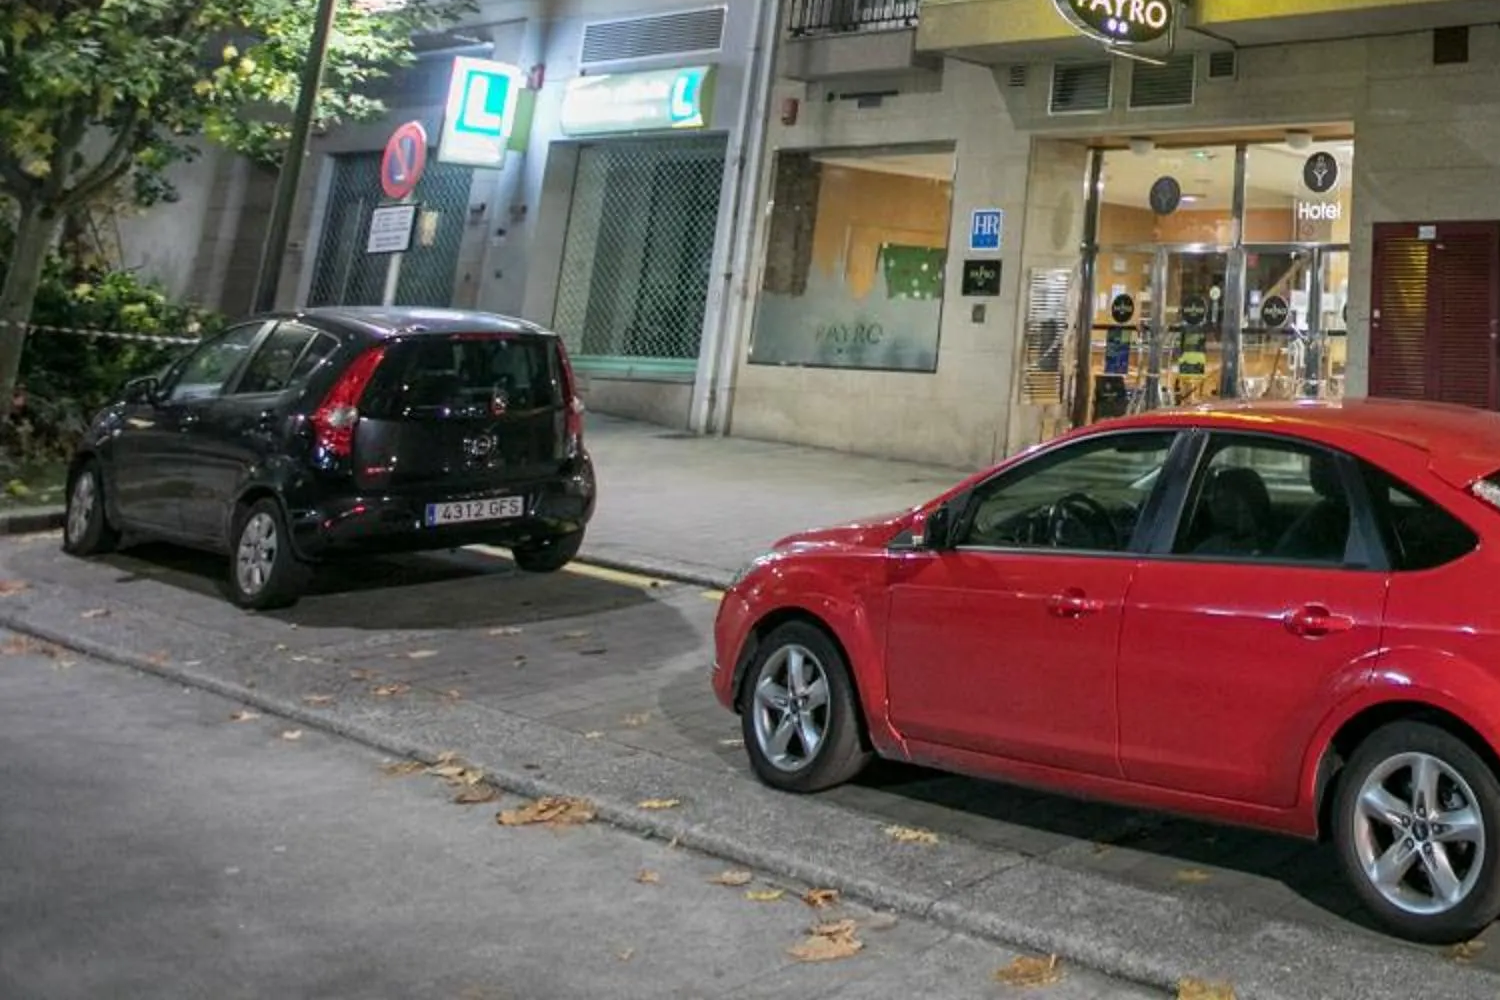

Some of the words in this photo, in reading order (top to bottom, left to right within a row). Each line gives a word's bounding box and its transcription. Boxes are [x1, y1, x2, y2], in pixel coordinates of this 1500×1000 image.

[1298, 202, 1341, 220] Hotel
[442, 502, 483, 520] 4312
[489, 500, 519, 515] GFS
